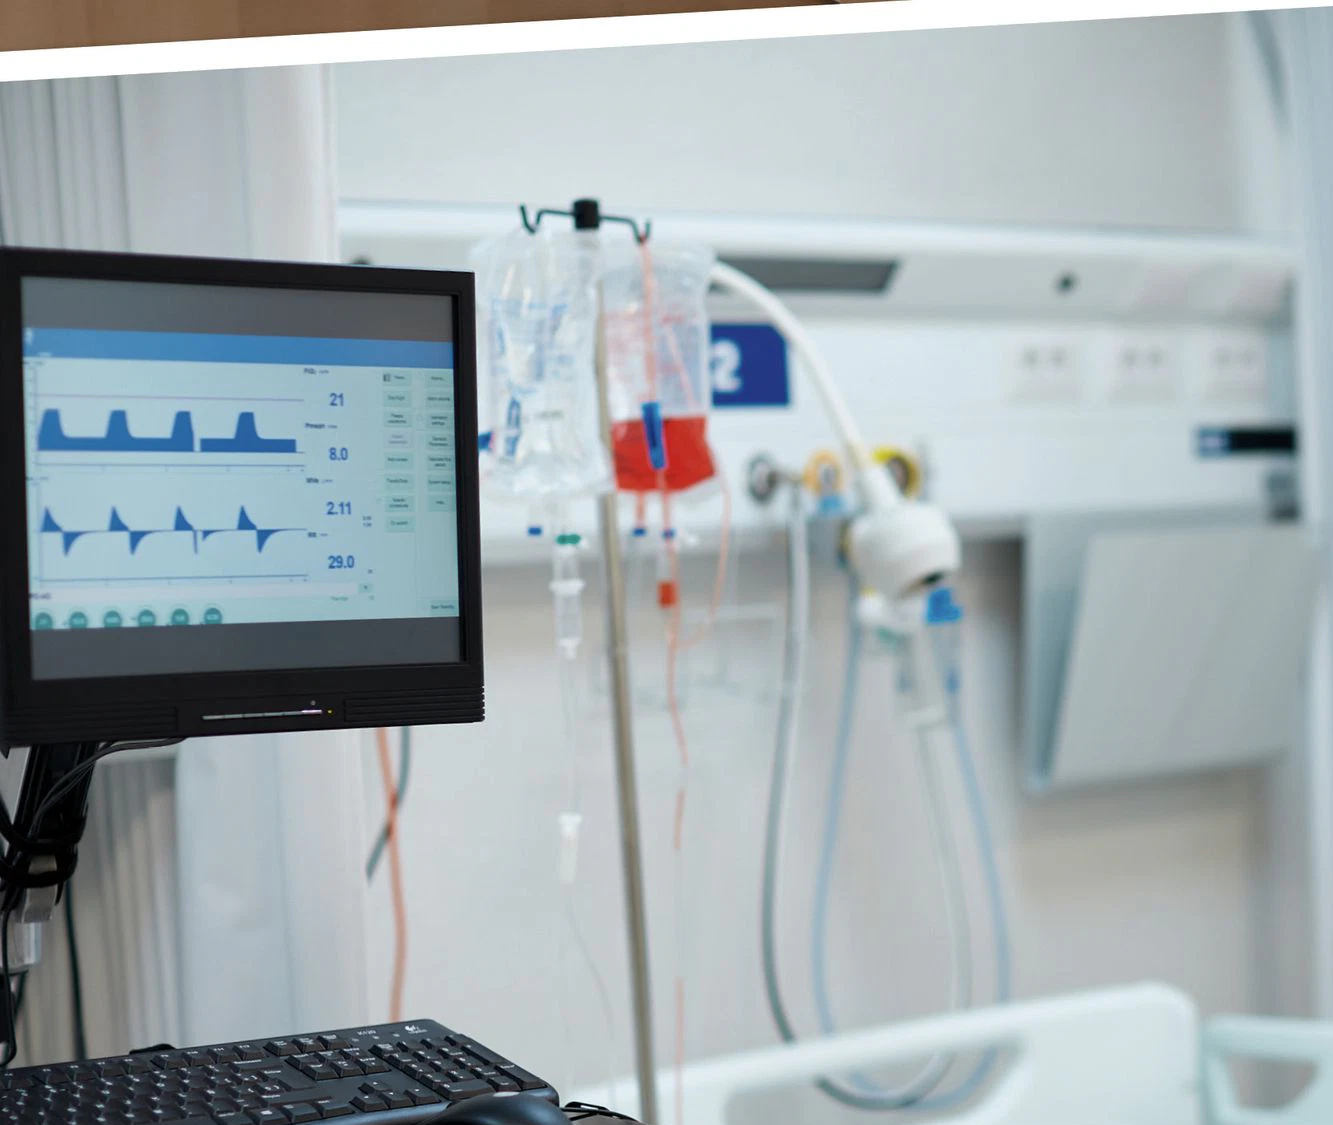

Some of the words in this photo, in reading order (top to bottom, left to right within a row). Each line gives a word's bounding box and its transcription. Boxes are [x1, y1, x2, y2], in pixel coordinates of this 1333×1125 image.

[329, 392, 344, 407] 21
[329, 447, 348, 461] 8.0
[326, 501, 352, 515] 2.11
[328, 555, 355, 569] 29.0
